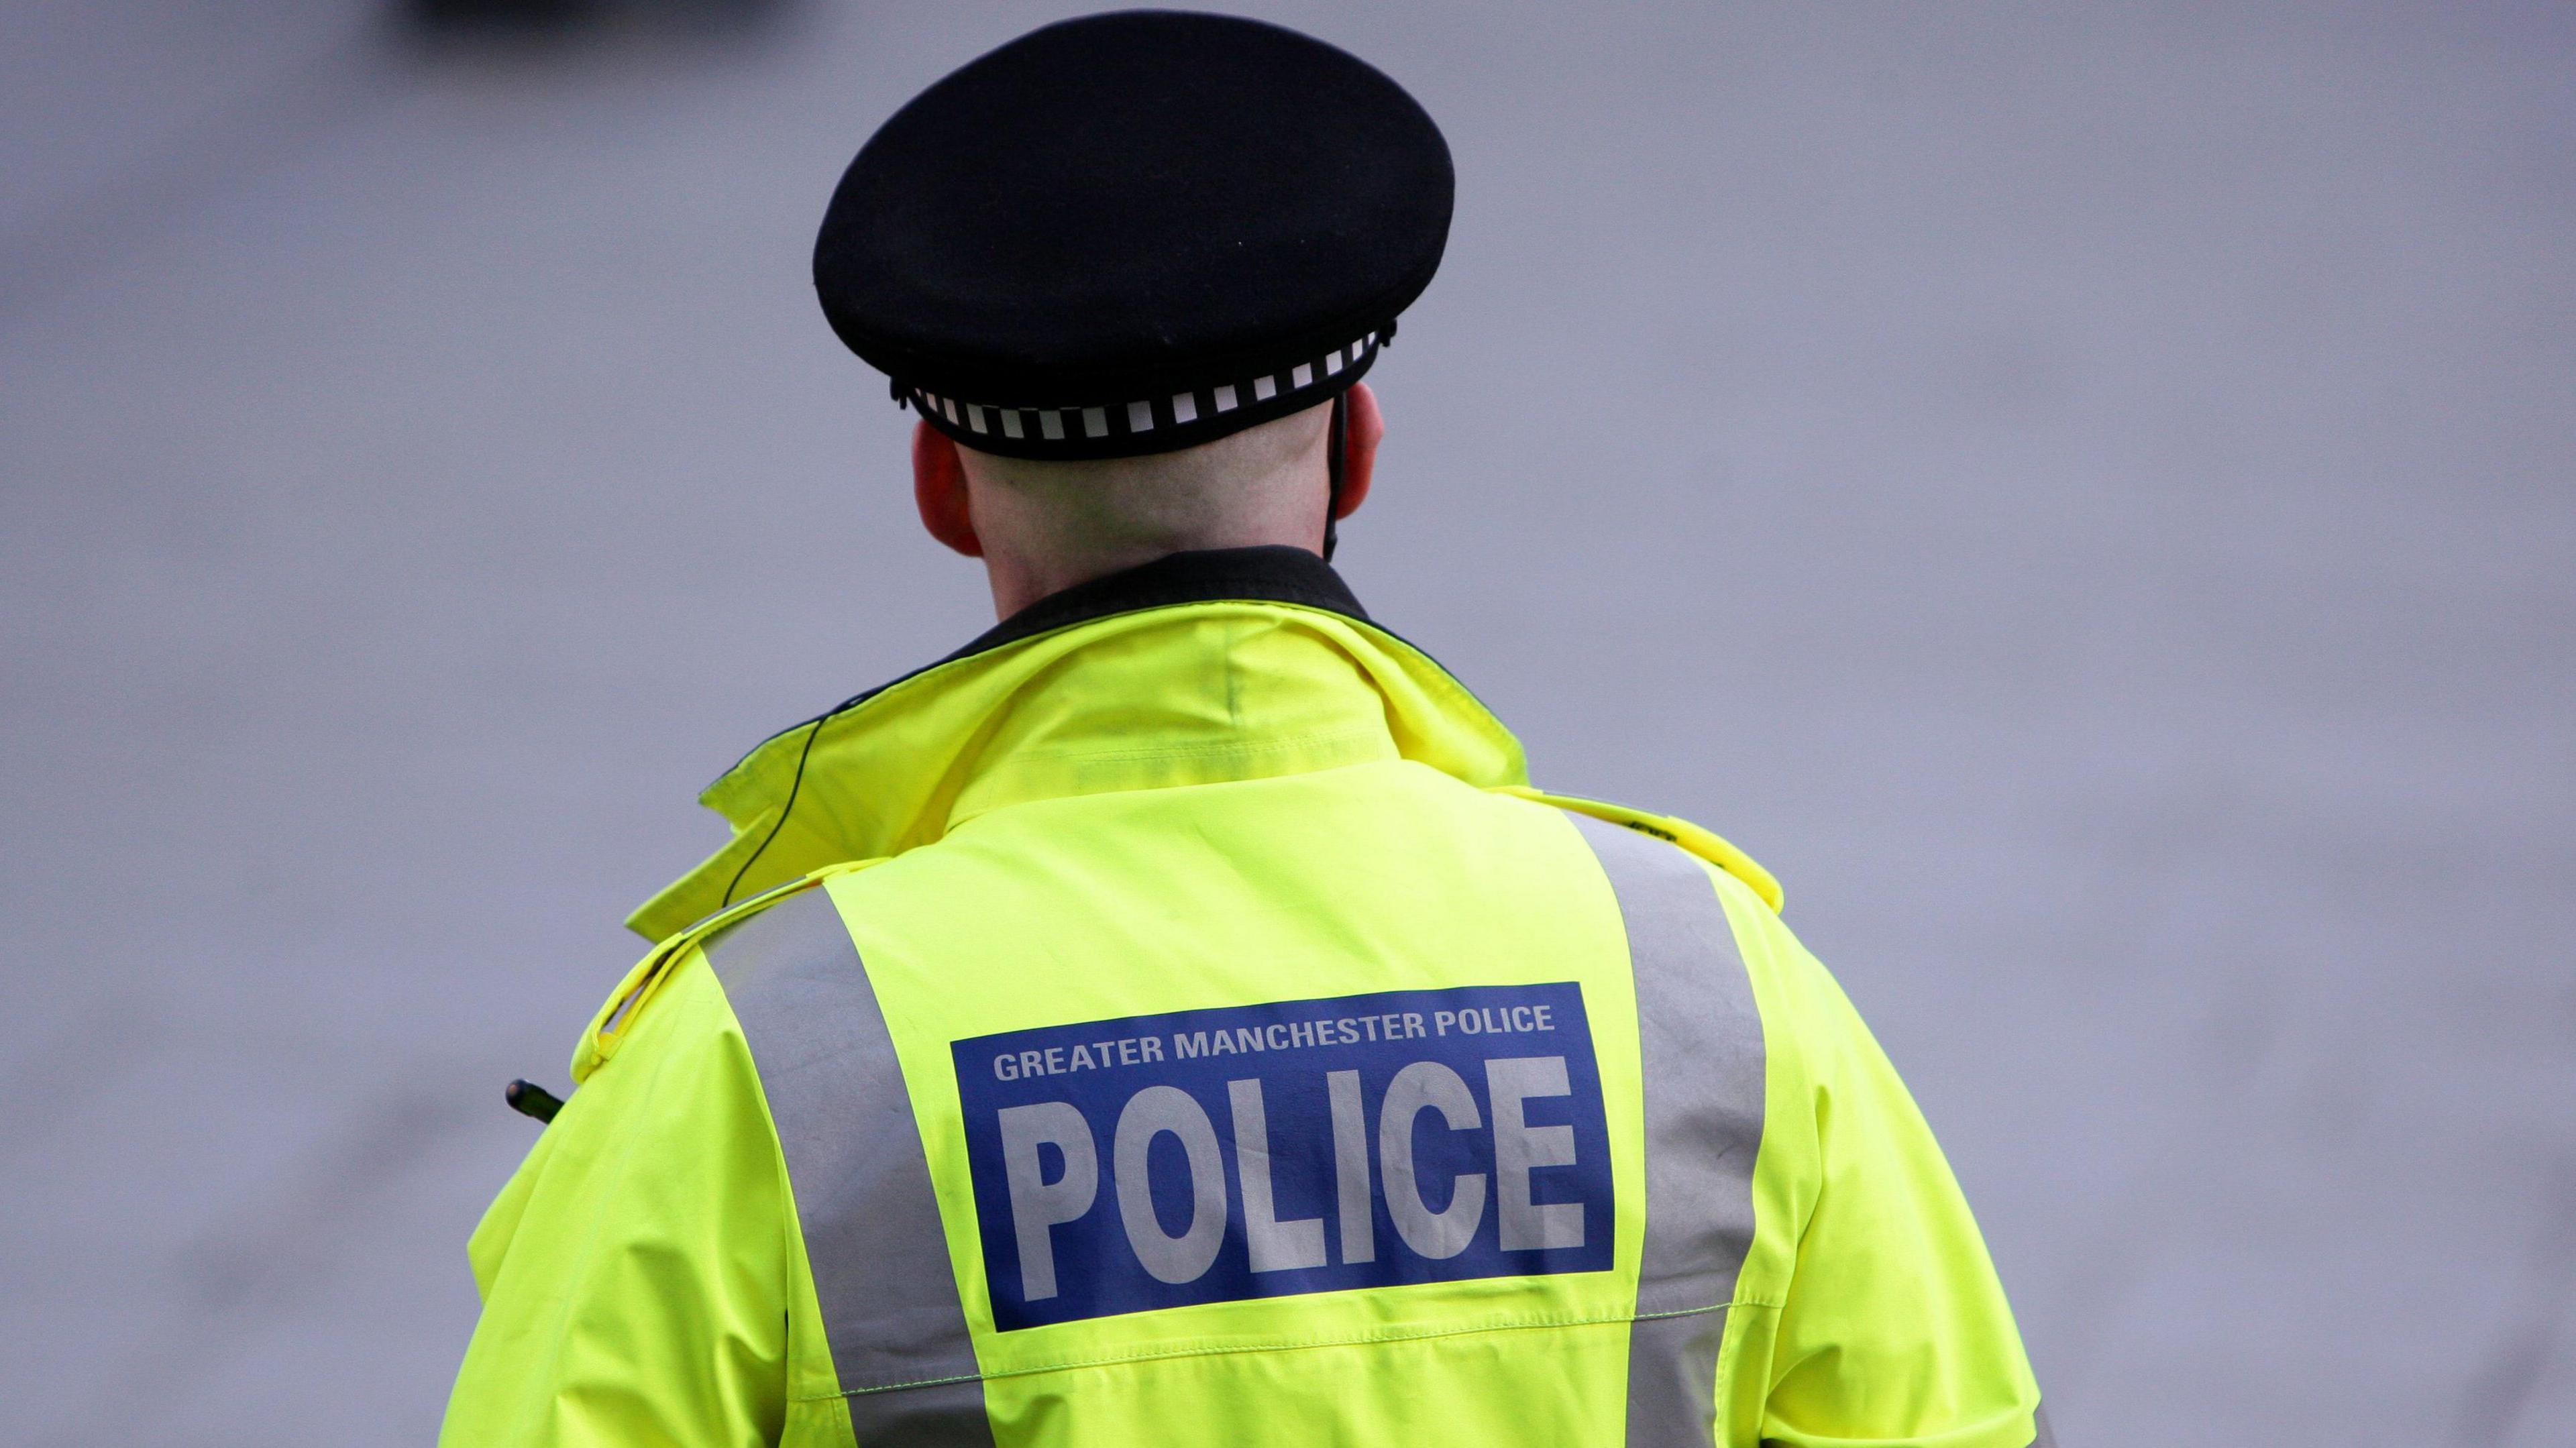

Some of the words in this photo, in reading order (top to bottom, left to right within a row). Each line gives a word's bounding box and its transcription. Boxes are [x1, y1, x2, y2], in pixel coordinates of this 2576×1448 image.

[994, 1036, 1164, 1082] GREATER
[1173, 1012, 1426, 1059] MANCHESTER
[1434, 1005, 1555, 1037] POLICE
[998, 1055, 1585, 1301] POLICE
